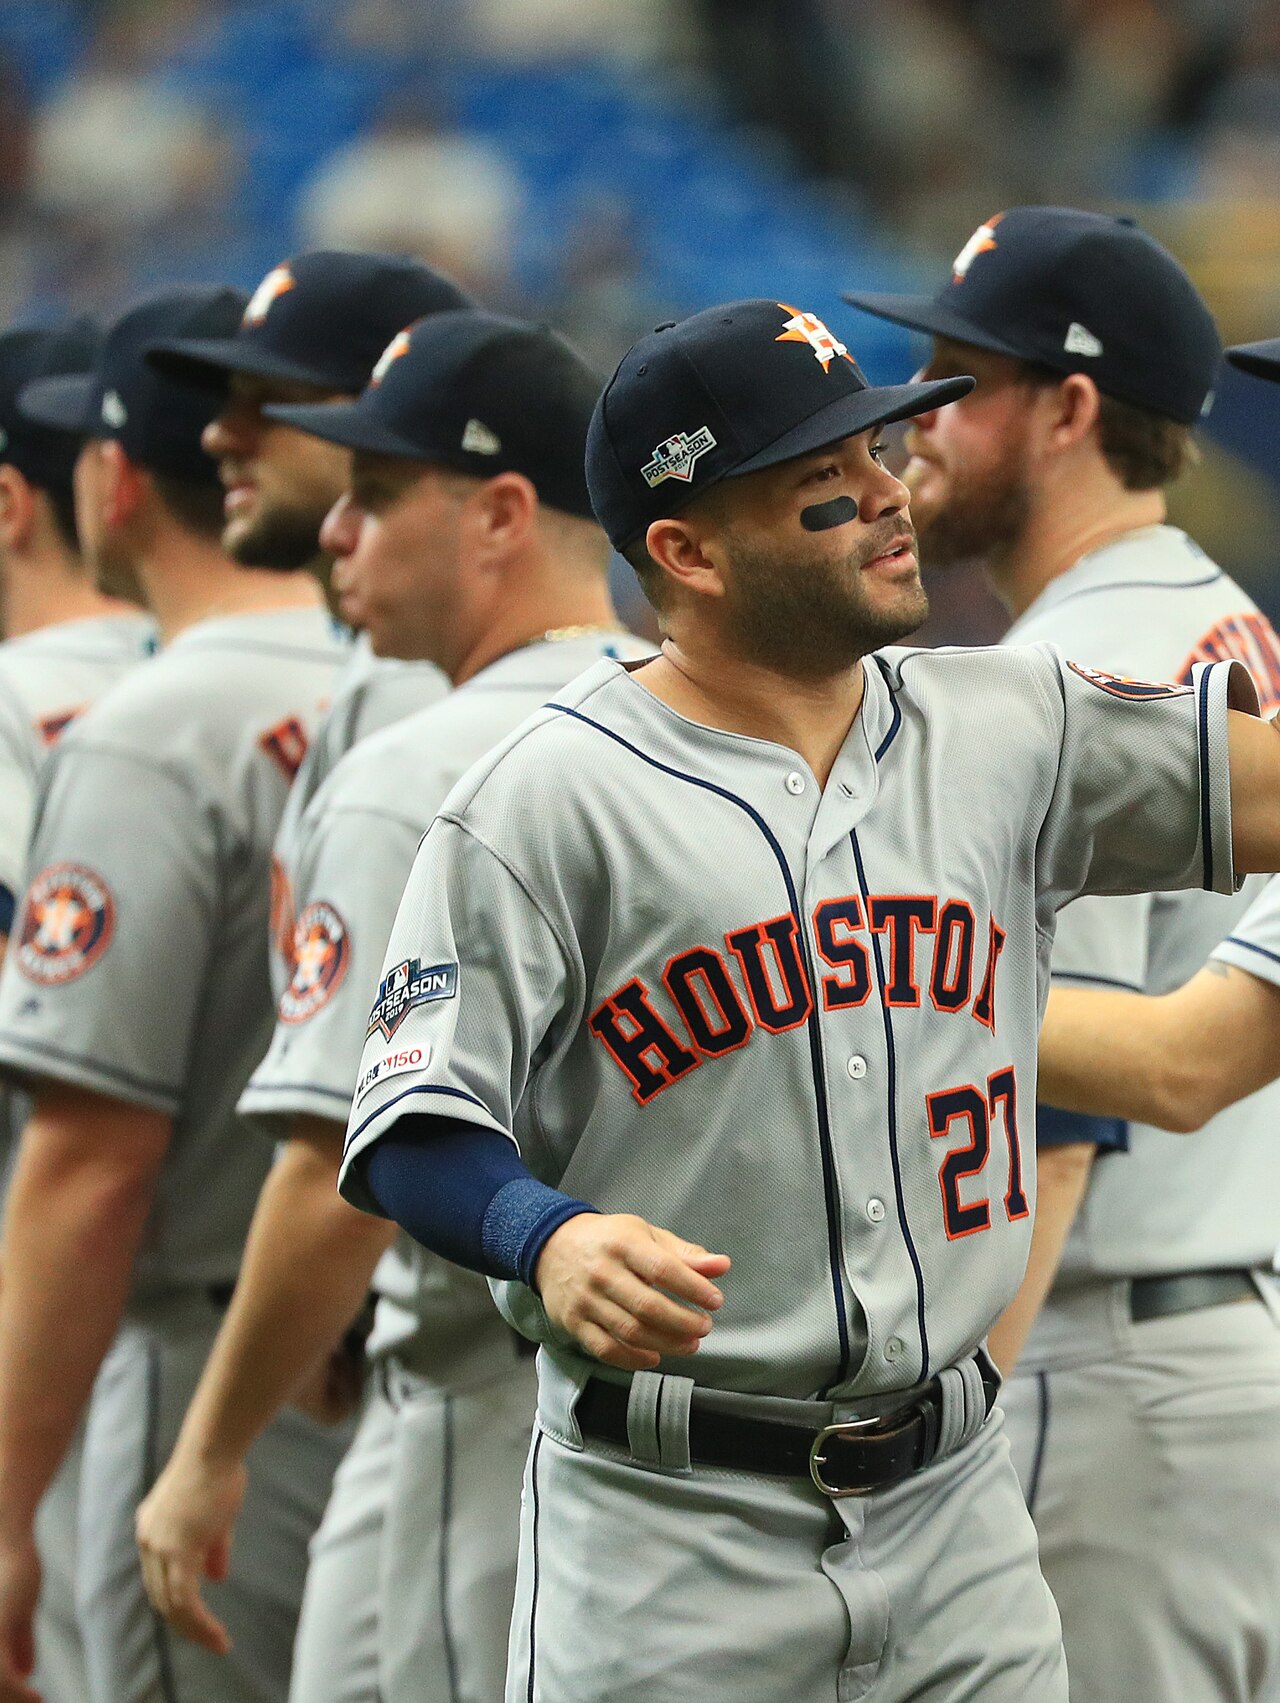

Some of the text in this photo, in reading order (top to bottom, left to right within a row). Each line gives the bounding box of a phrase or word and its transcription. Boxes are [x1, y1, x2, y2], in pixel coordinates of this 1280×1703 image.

[646, 435, 710, 481] POSTSEASON
[385, 1002, 404, 1022] 2019
[587, 894, 1006, 1107] HOUSTON
[393, 1049, 422, 1069] 150
[925, 1064, 1030, 1242] 27
